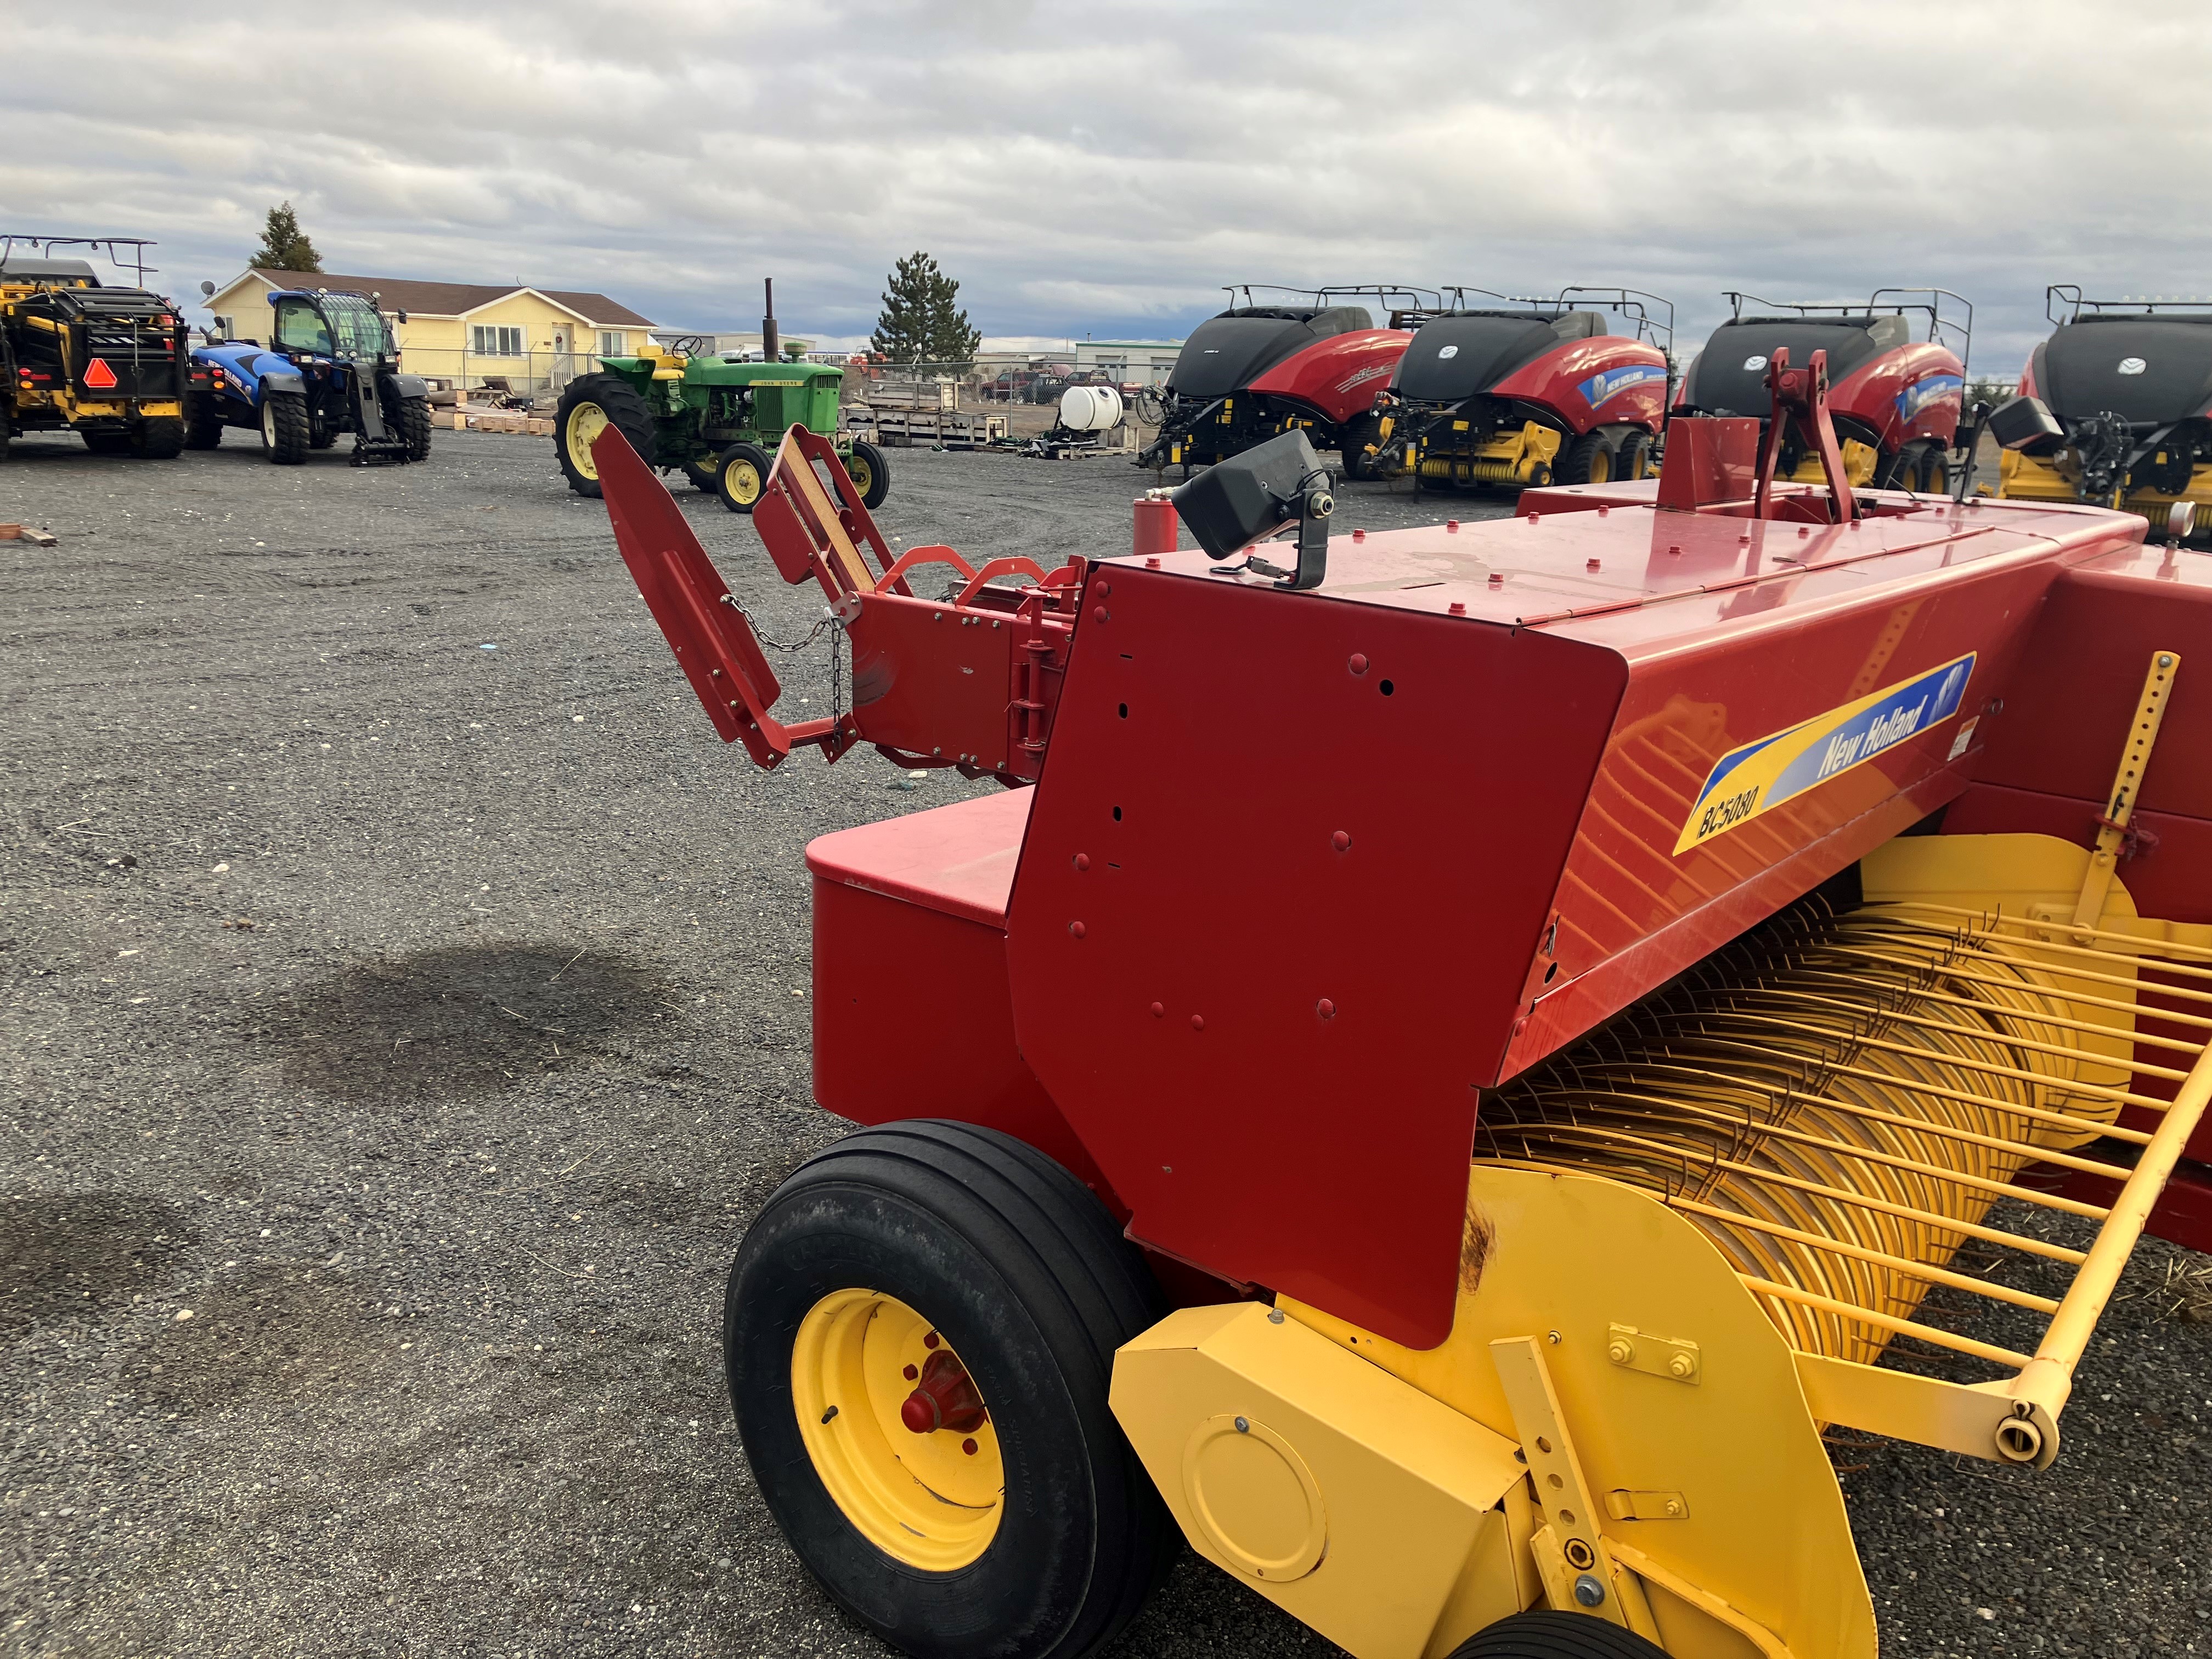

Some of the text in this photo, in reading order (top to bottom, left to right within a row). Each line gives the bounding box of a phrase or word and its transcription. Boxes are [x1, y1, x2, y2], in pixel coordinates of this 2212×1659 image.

[1607, 371, 1643, 393] NEW HOLLAND
[1817, 733, 1866, 780] New
[1860, 695, 1928, 758] Holland
[1696, 785, 1759, 840] BC5080
